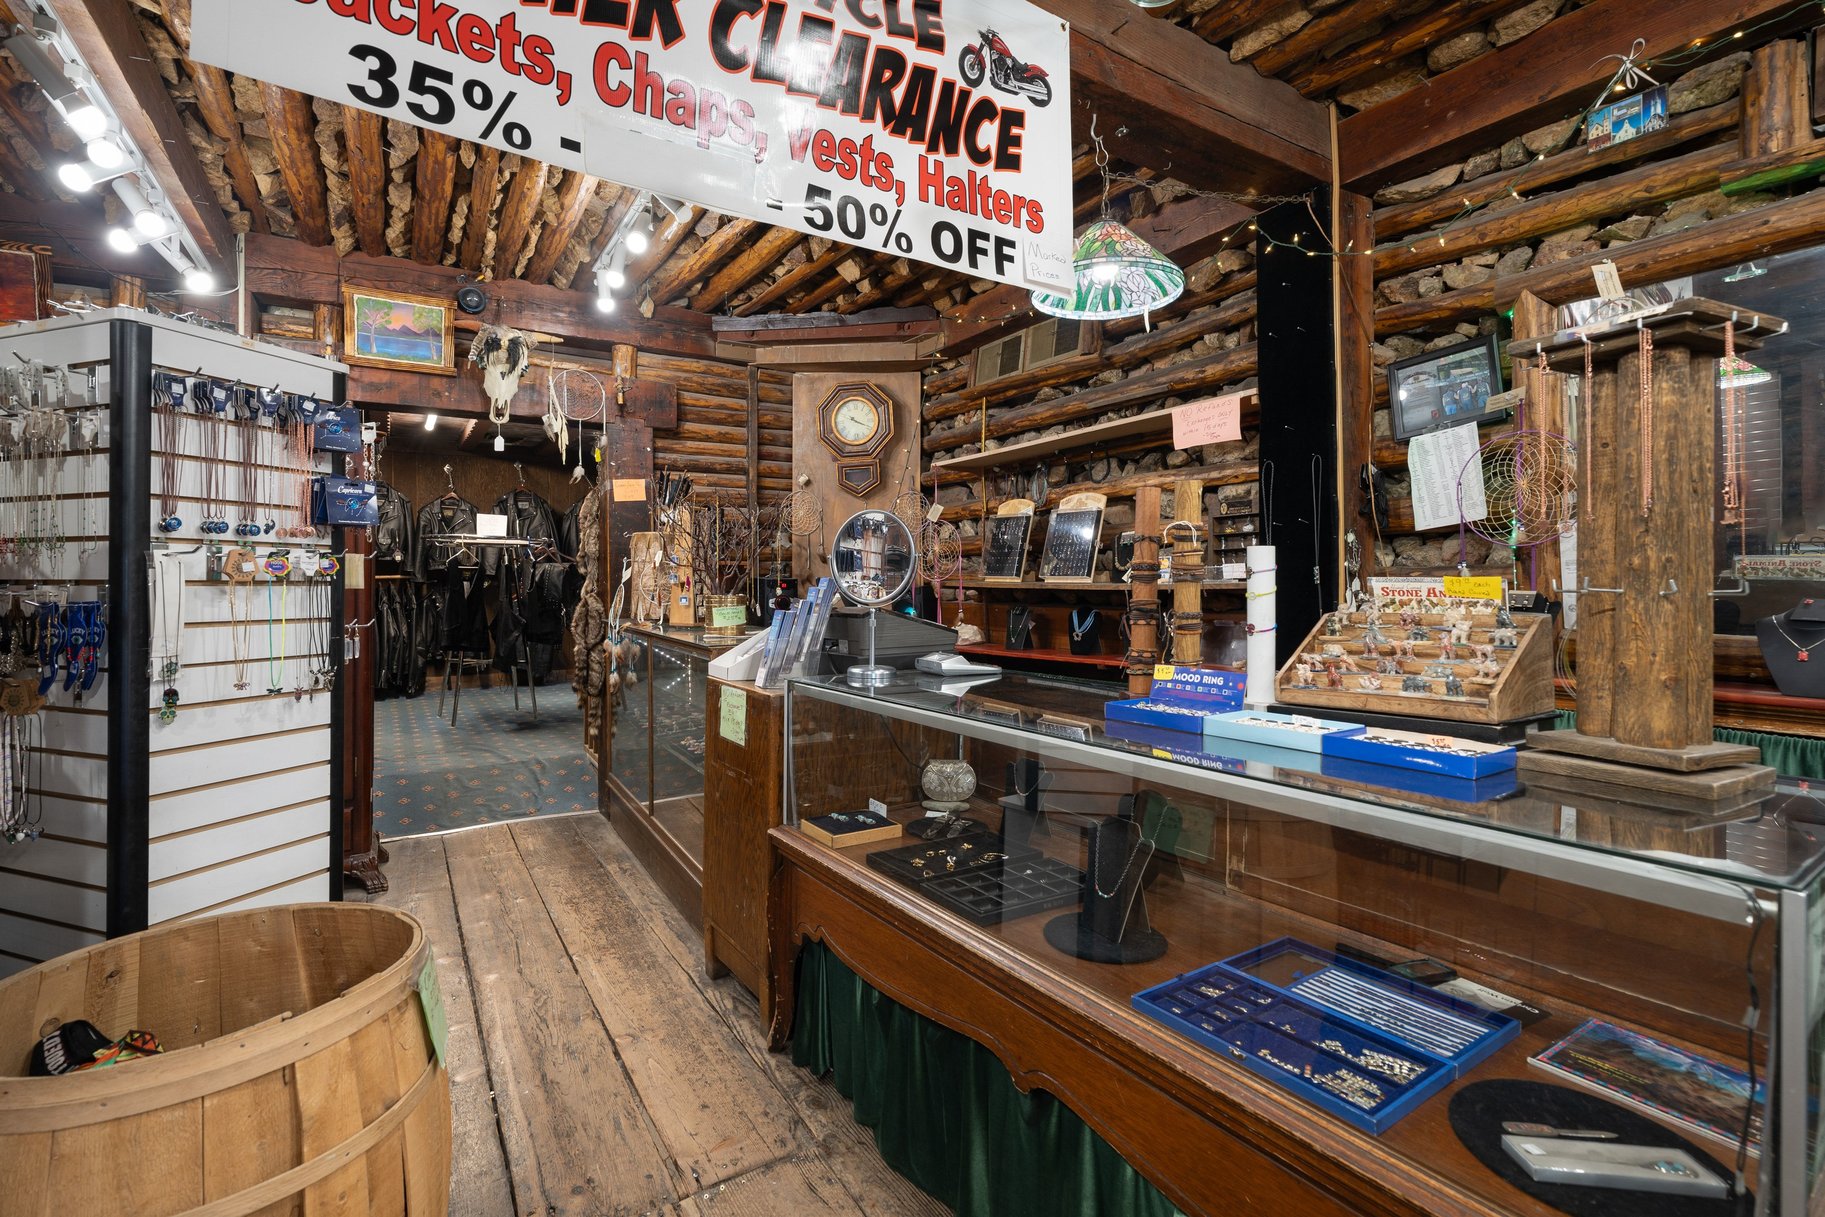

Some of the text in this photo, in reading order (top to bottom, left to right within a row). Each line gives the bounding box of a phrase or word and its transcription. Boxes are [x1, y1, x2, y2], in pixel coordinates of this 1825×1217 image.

[294, 0, 572, 106] ackets,
[593, 41, 768, 164] Chaps,
[786, 106, 905, 207] Vests,
[919, 154, 1044, 234] Halters
[347, 44, 532, 151] 35%
[804, 183, 913, 254] 50%
[930, 220, 1016, 277] OFF
[709, 0, 1026, 172] CLEARANCE
[1381, 586, 1423, 598] STONE
[1173, 672, 1200, 684] MOOD
[1202, 675, 1224, 686] RING
